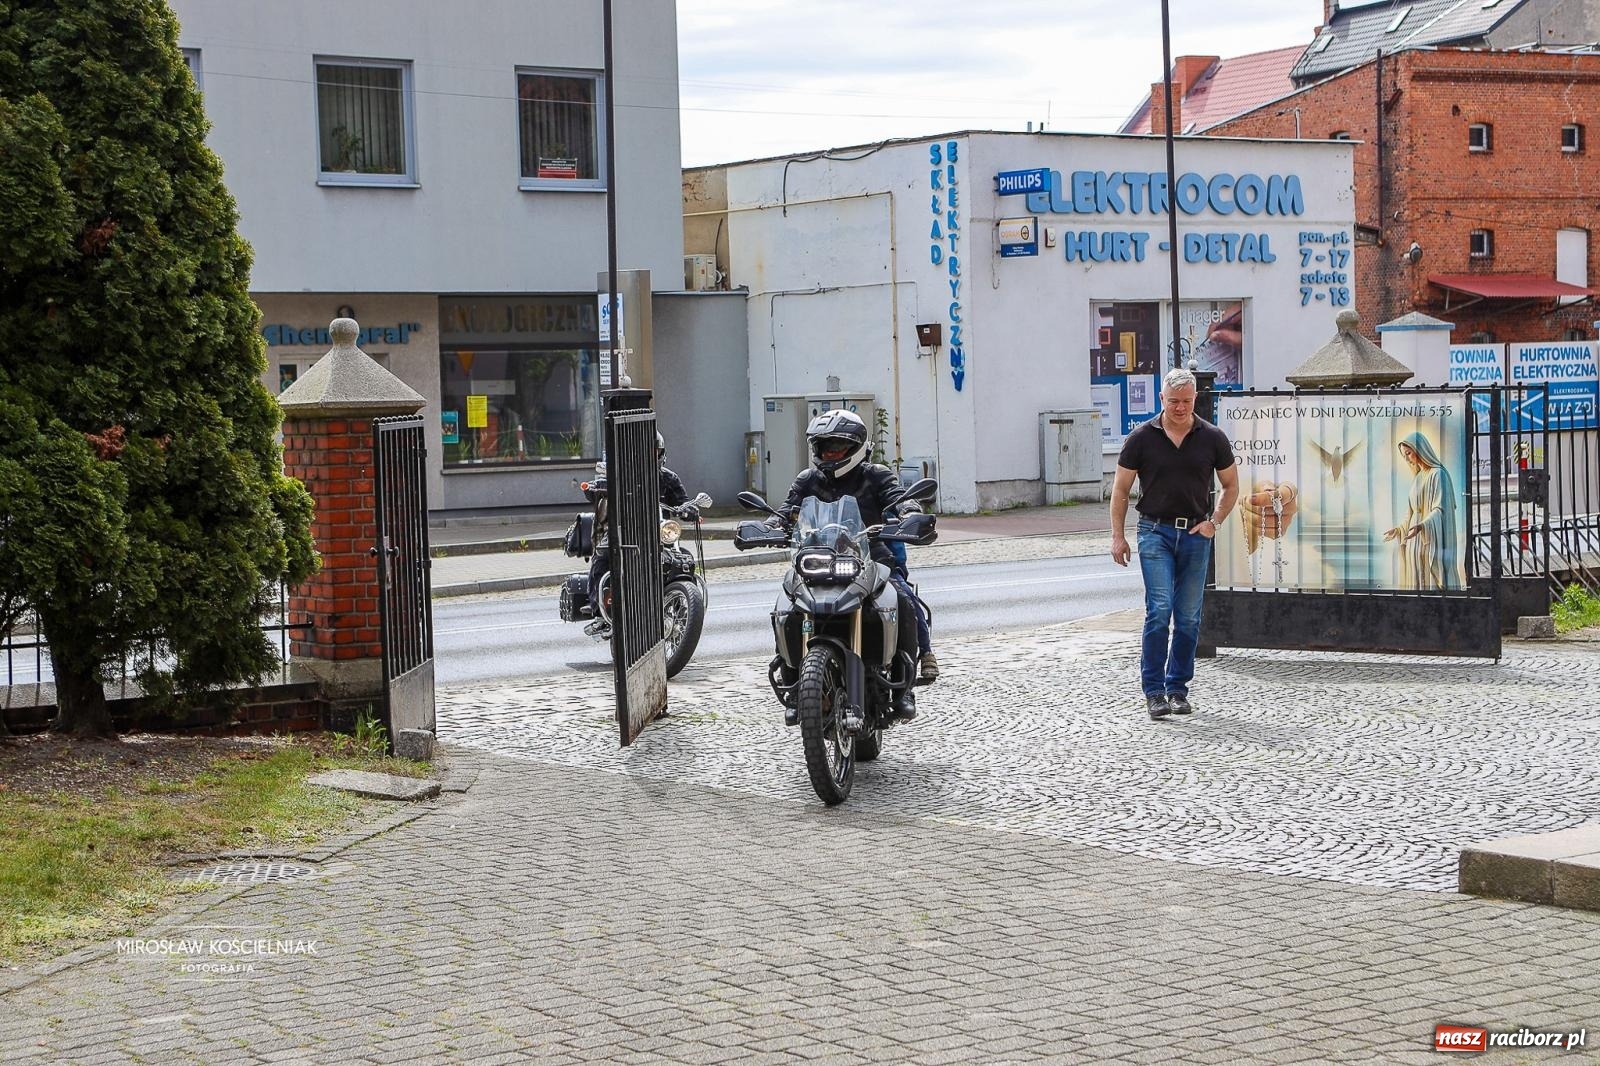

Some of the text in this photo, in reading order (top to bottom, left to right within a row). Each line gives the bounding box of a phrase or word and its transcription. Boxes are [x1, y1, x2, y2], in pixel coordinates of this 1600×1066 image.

[999, 173, 1042, 191] PHILIPS
[1026, 171, 1305, 216] ELEKTROCOM
[929, 143, 944, 266] SKŁAD
[1065, 230, 1149, 263] HURT
[1184, 232, 1276, 264] DETAL
[946, 140, 965, 392] ELEKTRYCZNY
[1299, 248, 1313, 268] 7
[1329, 248, 1350, 269] 17
[1300, 270, 1347, 284] sobota
[1300, 287, 1313, 307] 7
[1329, 287, 1350, 307] 13
[1450, 349, 1496, 363] TOWNIA
[1520, 346, 1591, 362] HURTOWNIA
[1450, 366, 1502, 381] TRYCZNA
[1513, 363, 1597, 379] ELEKTRYCZNA
[1226, 407, 1292, 420] RÓŻANIEC
[1295, 407, 1307, 418] W
[1311, 407, 1335, 418] DNI
[1339, 405, 1426, 418] POWSZEDNIE
[1430, 405, 1453, 417] 5:55
[1247, 455, 1286, 465] NIEBA!
